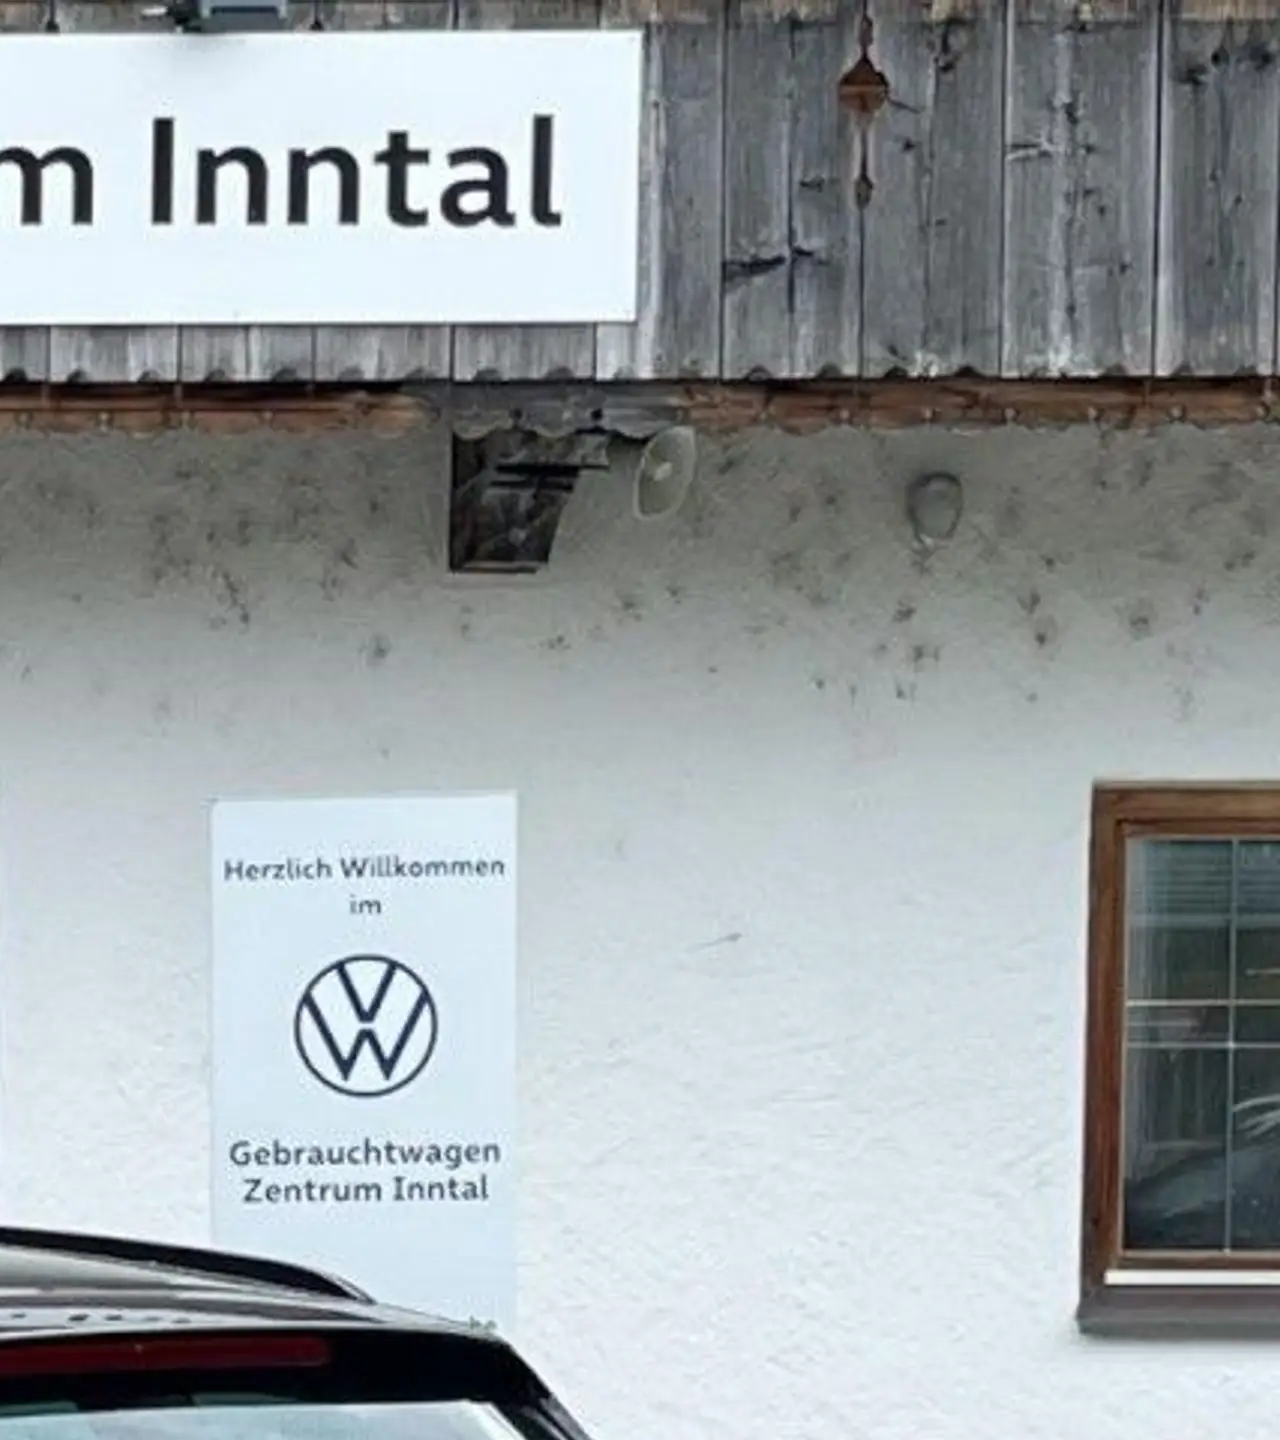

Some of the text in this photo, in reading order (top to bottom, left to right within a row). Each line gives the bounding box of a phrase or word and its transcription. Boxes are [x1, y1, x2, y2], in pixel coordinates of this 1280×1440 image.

[150, 113, 563, 229] Inntal
[223, 854, 506, 881] Herzlich Willkommen
[348, 894, 383, 916] im
[228, 1136, 501, 1170] Gebrauchtwagen
[242, 1172, 490, 1204] Zentrum Inntal
